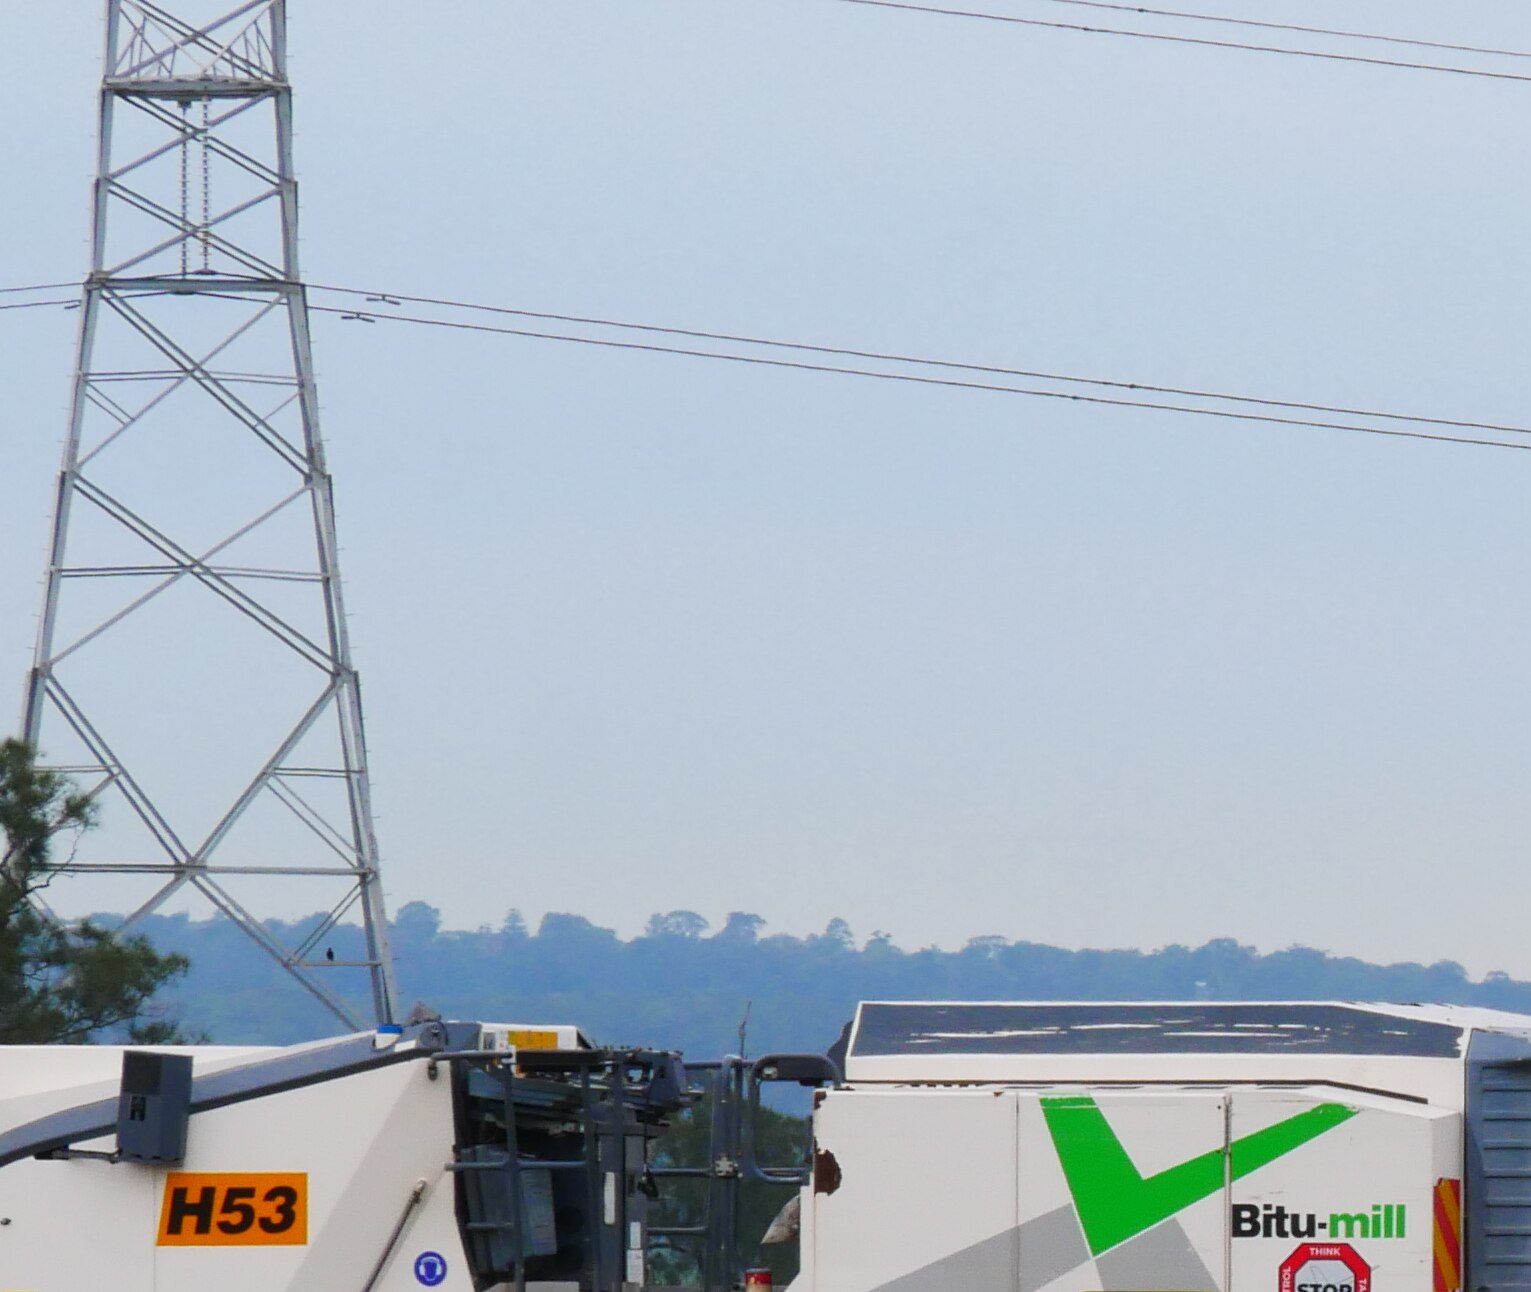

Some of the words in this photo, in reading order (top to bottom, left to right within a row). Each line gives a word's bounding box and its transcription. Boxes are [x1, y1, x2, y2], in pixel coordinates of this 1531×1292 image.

[167, 1186, 298, 1235] H53
[1232, 1203, 1406, 1239] Bitu-mill
[1309, 1247, 1341, 1256] THINK
